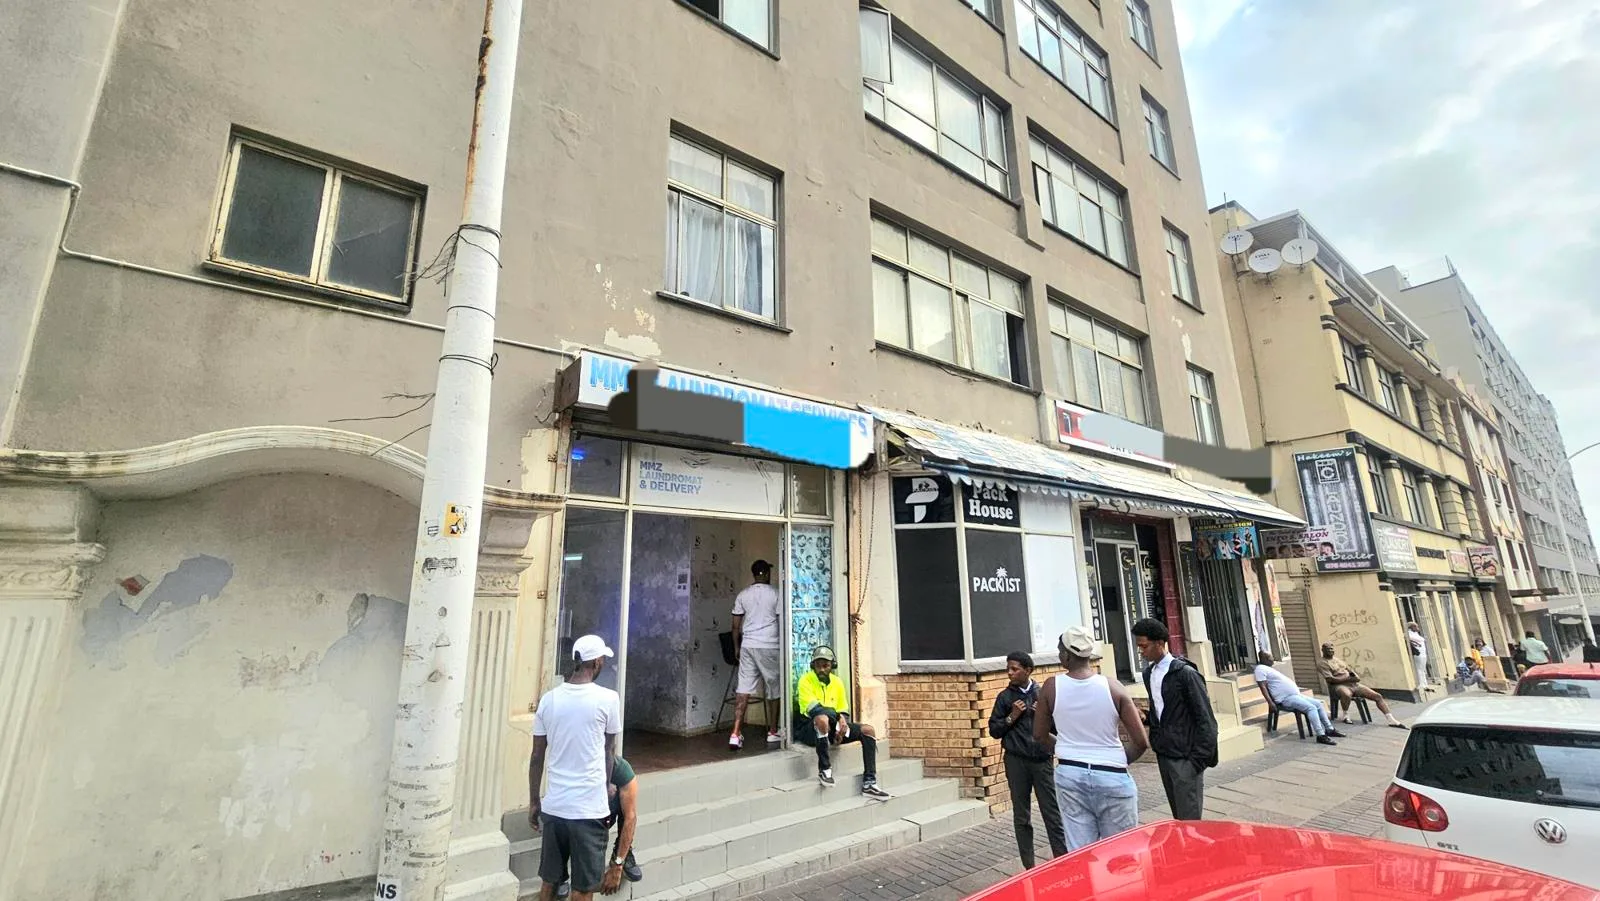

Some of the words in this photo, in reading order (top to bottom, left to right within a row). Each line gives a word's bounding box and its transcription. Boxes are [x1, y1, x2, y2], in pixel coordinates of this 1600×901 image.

[640, 461, 662, 471] MMZ
[640, 471, 703, 484] LAUNDROMAT
[640, 480, 647, 488] &
[650, 481, 701, 494] DELIVERY
[969, 499, 1014, 520] House
